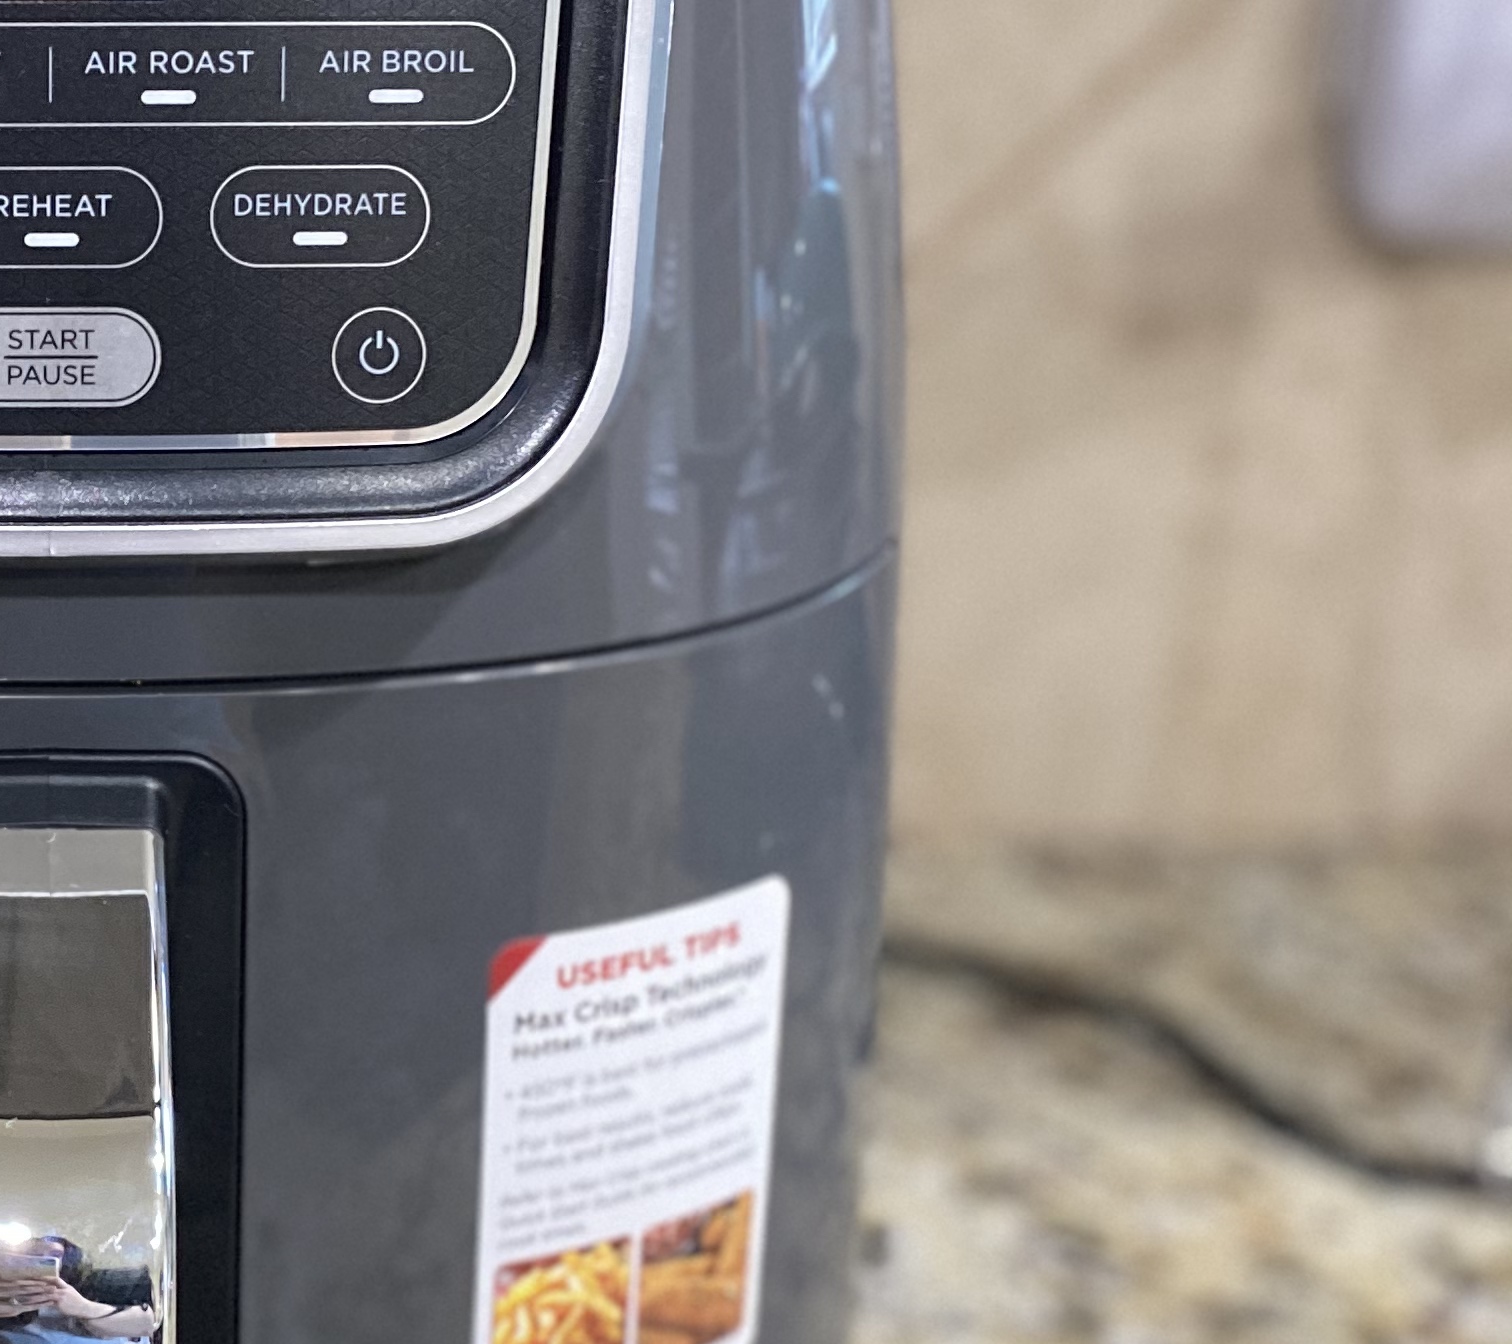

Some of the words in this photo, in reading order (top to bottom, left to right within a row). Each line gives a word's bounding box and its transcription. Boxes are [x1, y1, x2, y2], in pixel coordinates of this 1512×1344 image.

[84, 50, 137, 74] AIR
[150, 50, 255, 74] ROAST
[318, 49, 371, 73] AIR
[382, 49, 475, 73] BROIL
[233, 192, 408, 217] DEHYDRATE
[7, 329, 95, 351] START
[6, 364, 97, 386] PAUSE
[556, 945, 675, 990] USEFUL
[684, 921, 742, 960] TIPS
[514, 1009, 566, 1036] Max
[573, 992, 639, 1026] Crisp
